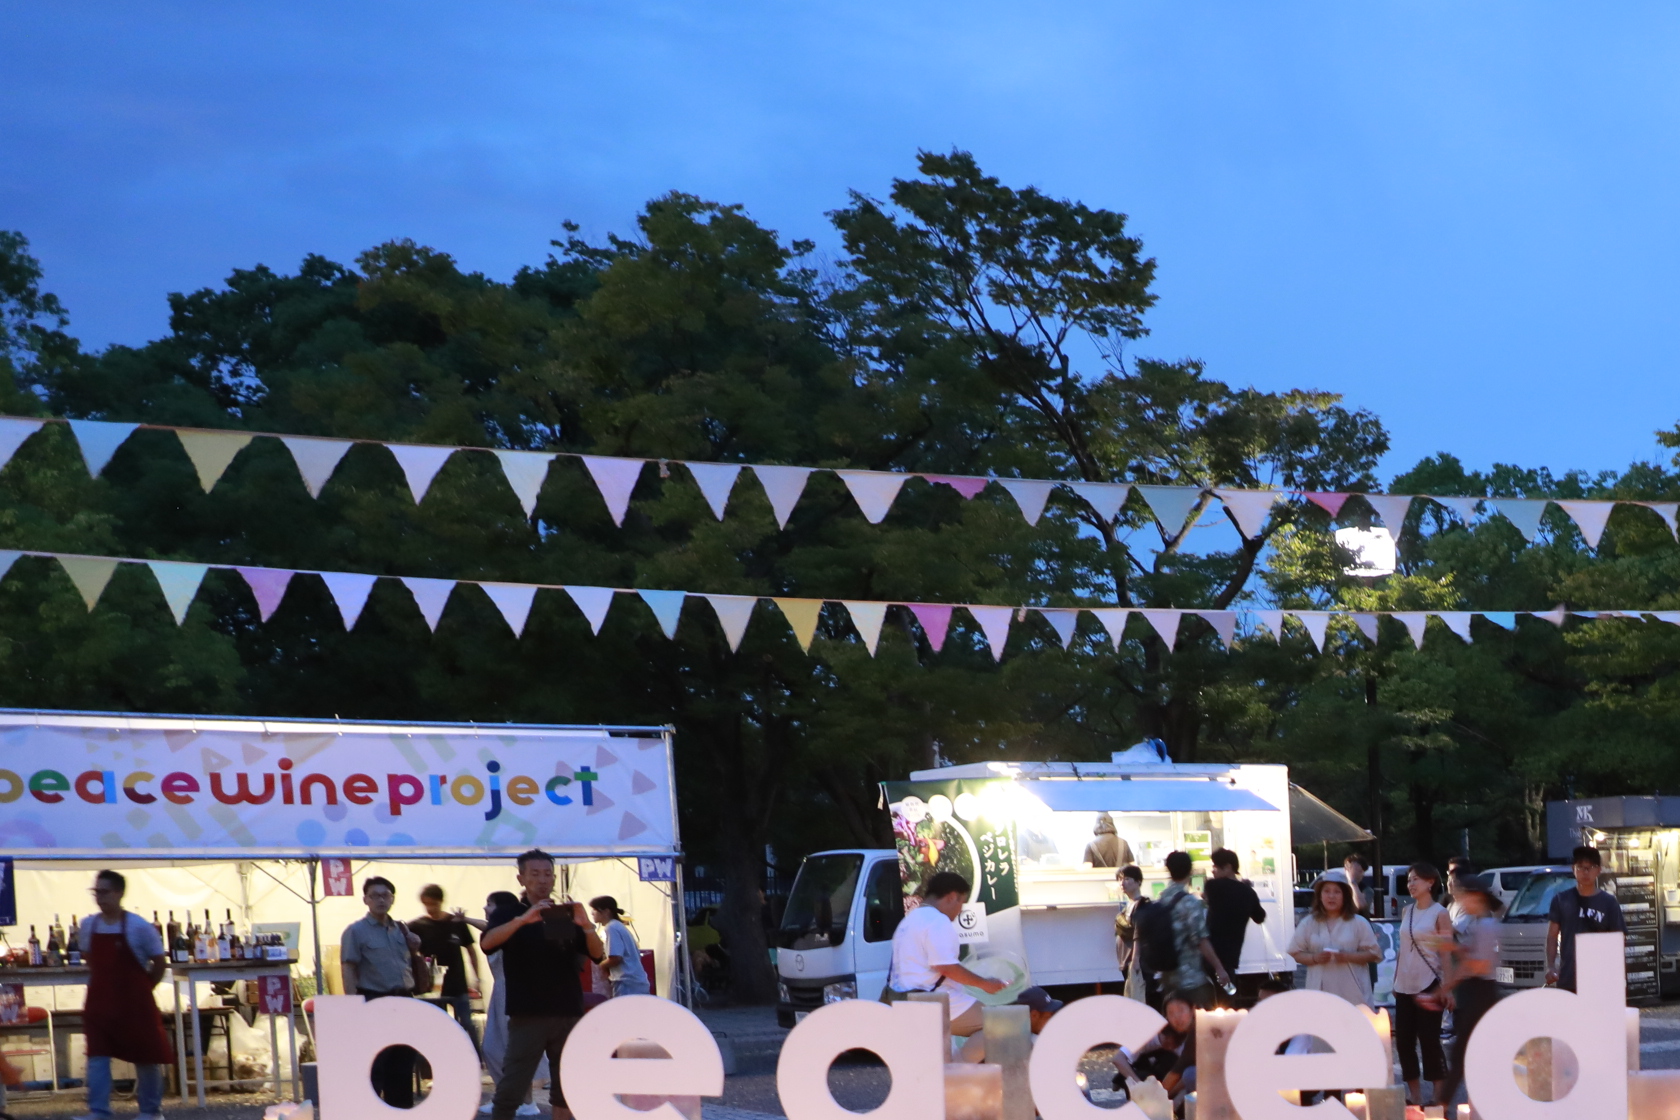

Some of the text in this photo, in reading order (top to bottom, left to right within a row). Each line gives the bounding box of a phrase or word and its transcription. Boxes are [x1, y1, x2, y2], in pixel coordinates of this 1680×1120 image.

[641, 858, 673, 878] PW
[979, 831, 998, 900] ベジカレー
